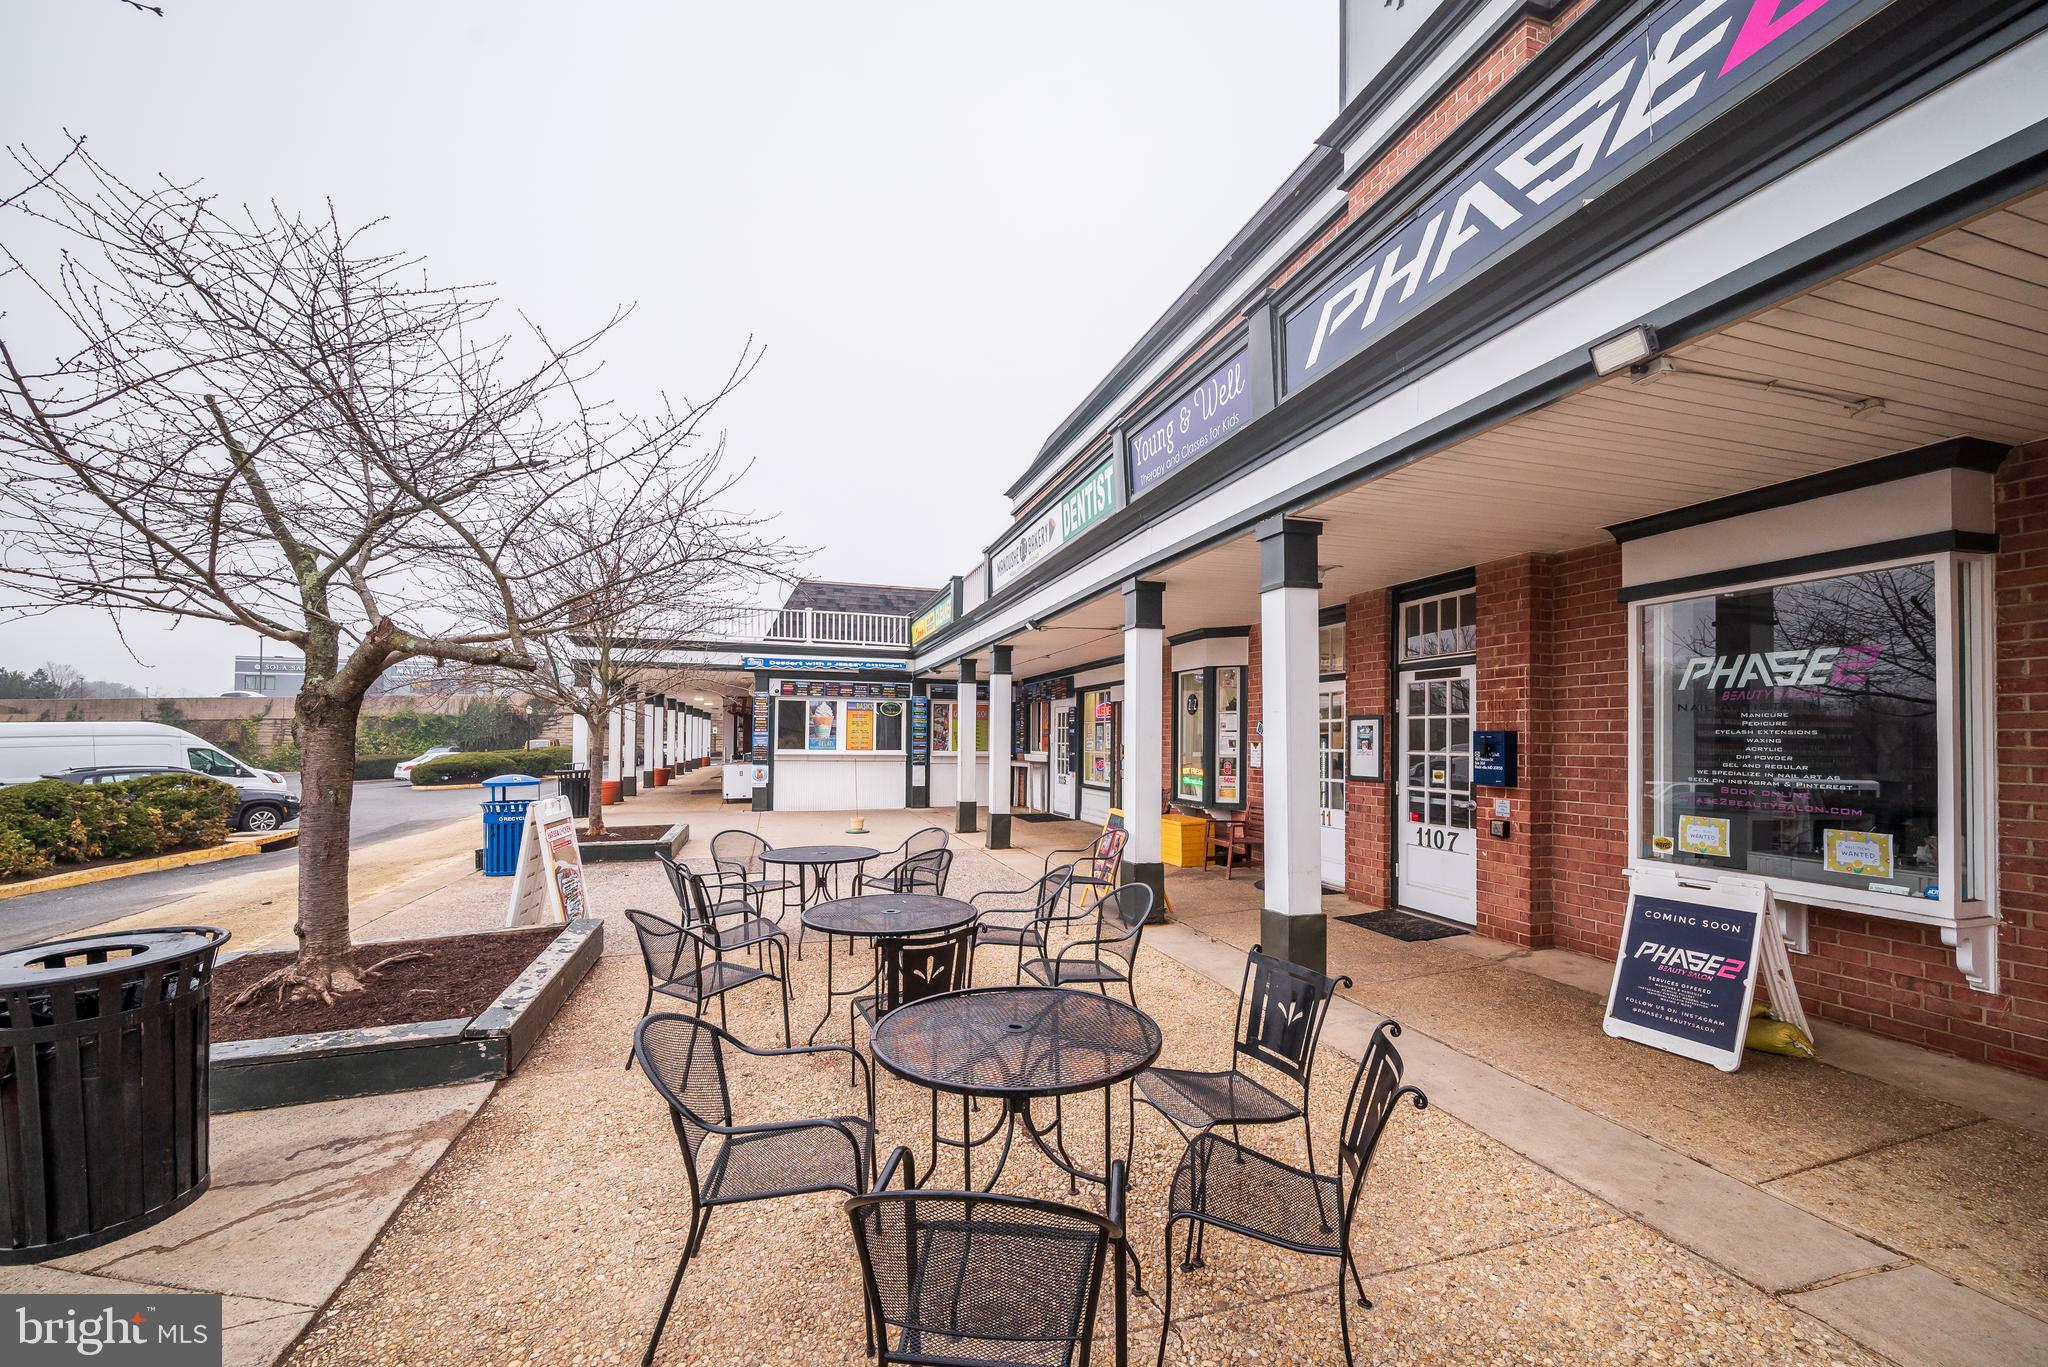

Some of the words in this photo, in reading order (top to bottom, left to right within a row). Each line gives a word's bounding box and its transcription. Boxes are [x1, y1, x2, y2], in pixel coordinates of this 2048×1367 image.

[1134, 420, 1174, 466] Young
[1180, 406, 1190, 434] &
[1194, 363, 1245, 420] Well
[1140, 463, 1165, 486] Therapy
[1166, 452, 1180, 469] and
[1181, 435, 1208, 459] Classes
[1209, 424, 1220, 439] for
[1222, 412, 1239, 432] Kids
[1062, 463, 1114, 537] DENTIST
[1028, 524, 1048, 555] BAKERY
[1678, 644, 1883, 691] PHASE2
[1721, 689, 1772, 701] BEAUTY
[1720, 786, 1756, 796] BOOK
[1761, 790, 1812, 800] ONLINE
[1728, 778, 1780, 787] INSTAGRAM
[1796, 782, 1853, 791] PINTEREST
[1319, 810, 1333, 827] 11
[1416, 826, 1459, 852] 1107
[1690, 833, 1716, 841] WANTED
[1841, 850, 1876, 859] WANTED
[1644, 909, 1697, 926] COMING
[1702, 919, 1742, 934] SOON
[1634, 941, 1746, 980] PHASE2
[1657, 964, 1686, 976] BEAUTY
[1686, 970, 1714, 982] SALON
[1648, 975, 1679, 987] SERVICES
[1681, 983, 1712, 995] OFFERED
[1625, 996, 1653, 1008] FOLLOW
[1681, 1011, 1725, 1027] INSTAGRAM
